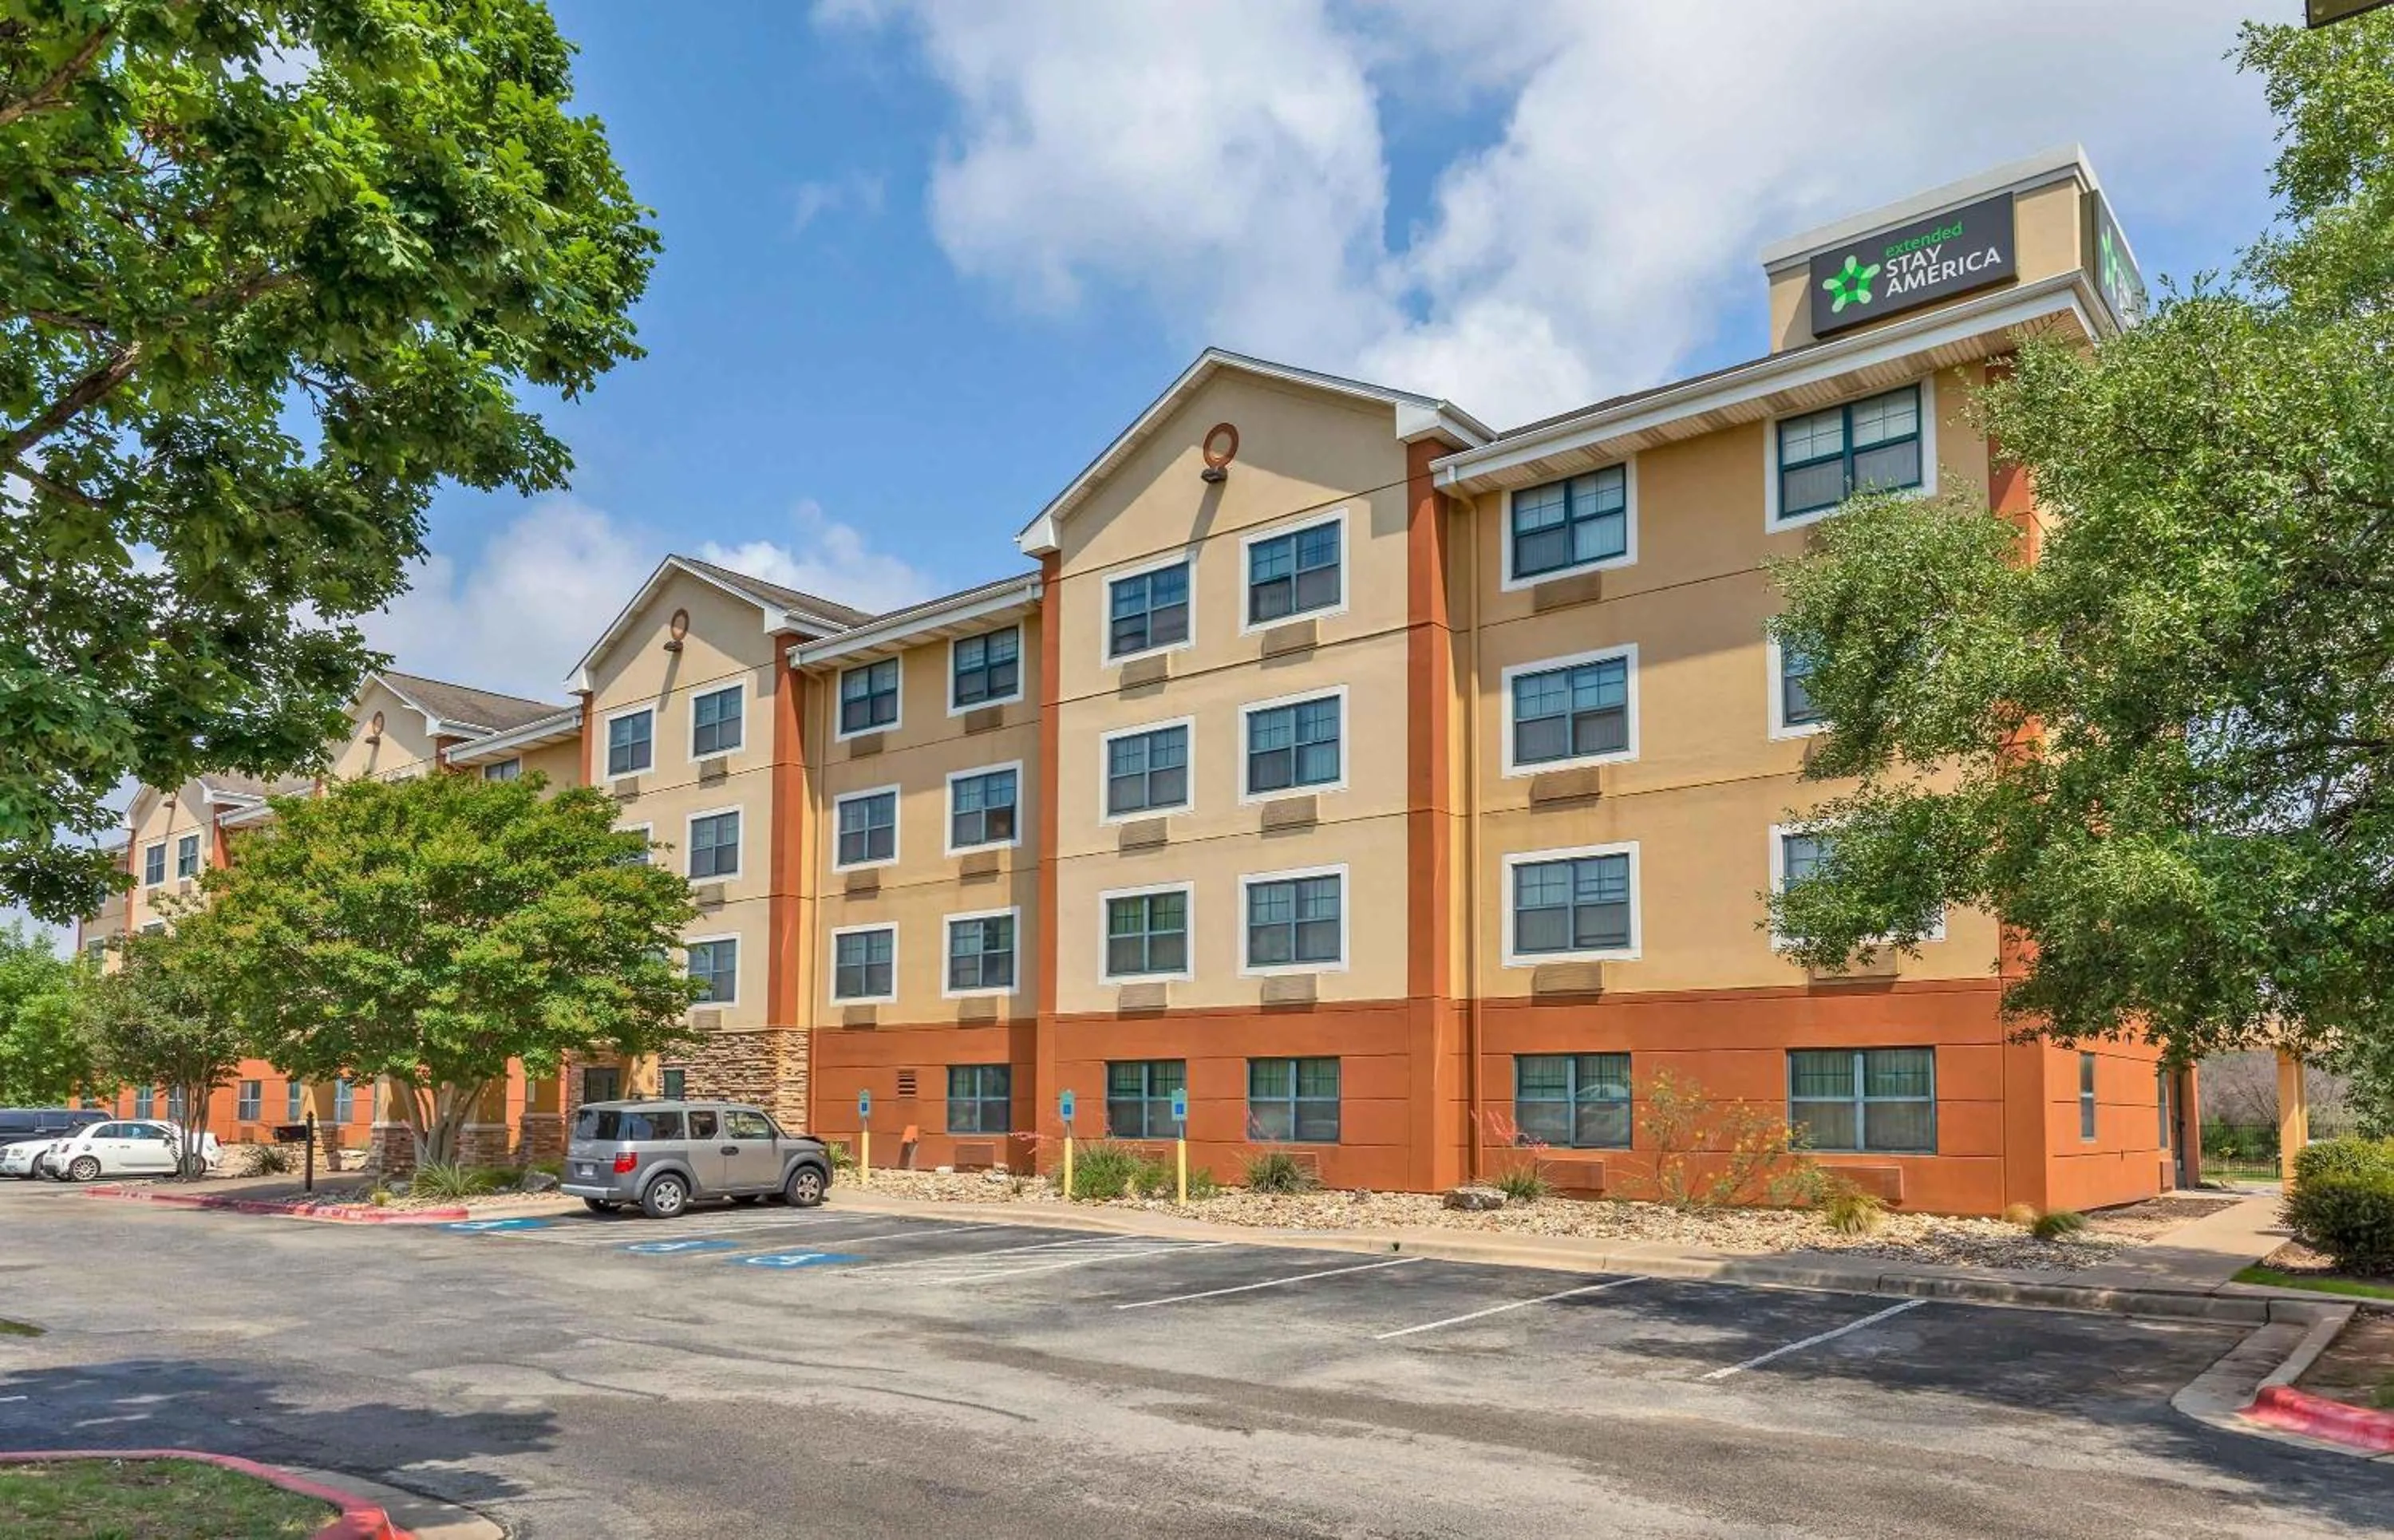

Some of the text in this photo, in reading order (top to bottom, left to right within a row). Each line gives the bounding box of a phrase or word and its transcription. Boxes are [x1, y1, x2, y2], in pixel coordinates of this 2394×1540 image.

[1886, 221, 1963, 256] extended
[1886, 244, 1942, 278] STAY
[1886, 247, 2001, 298] AMERICA
